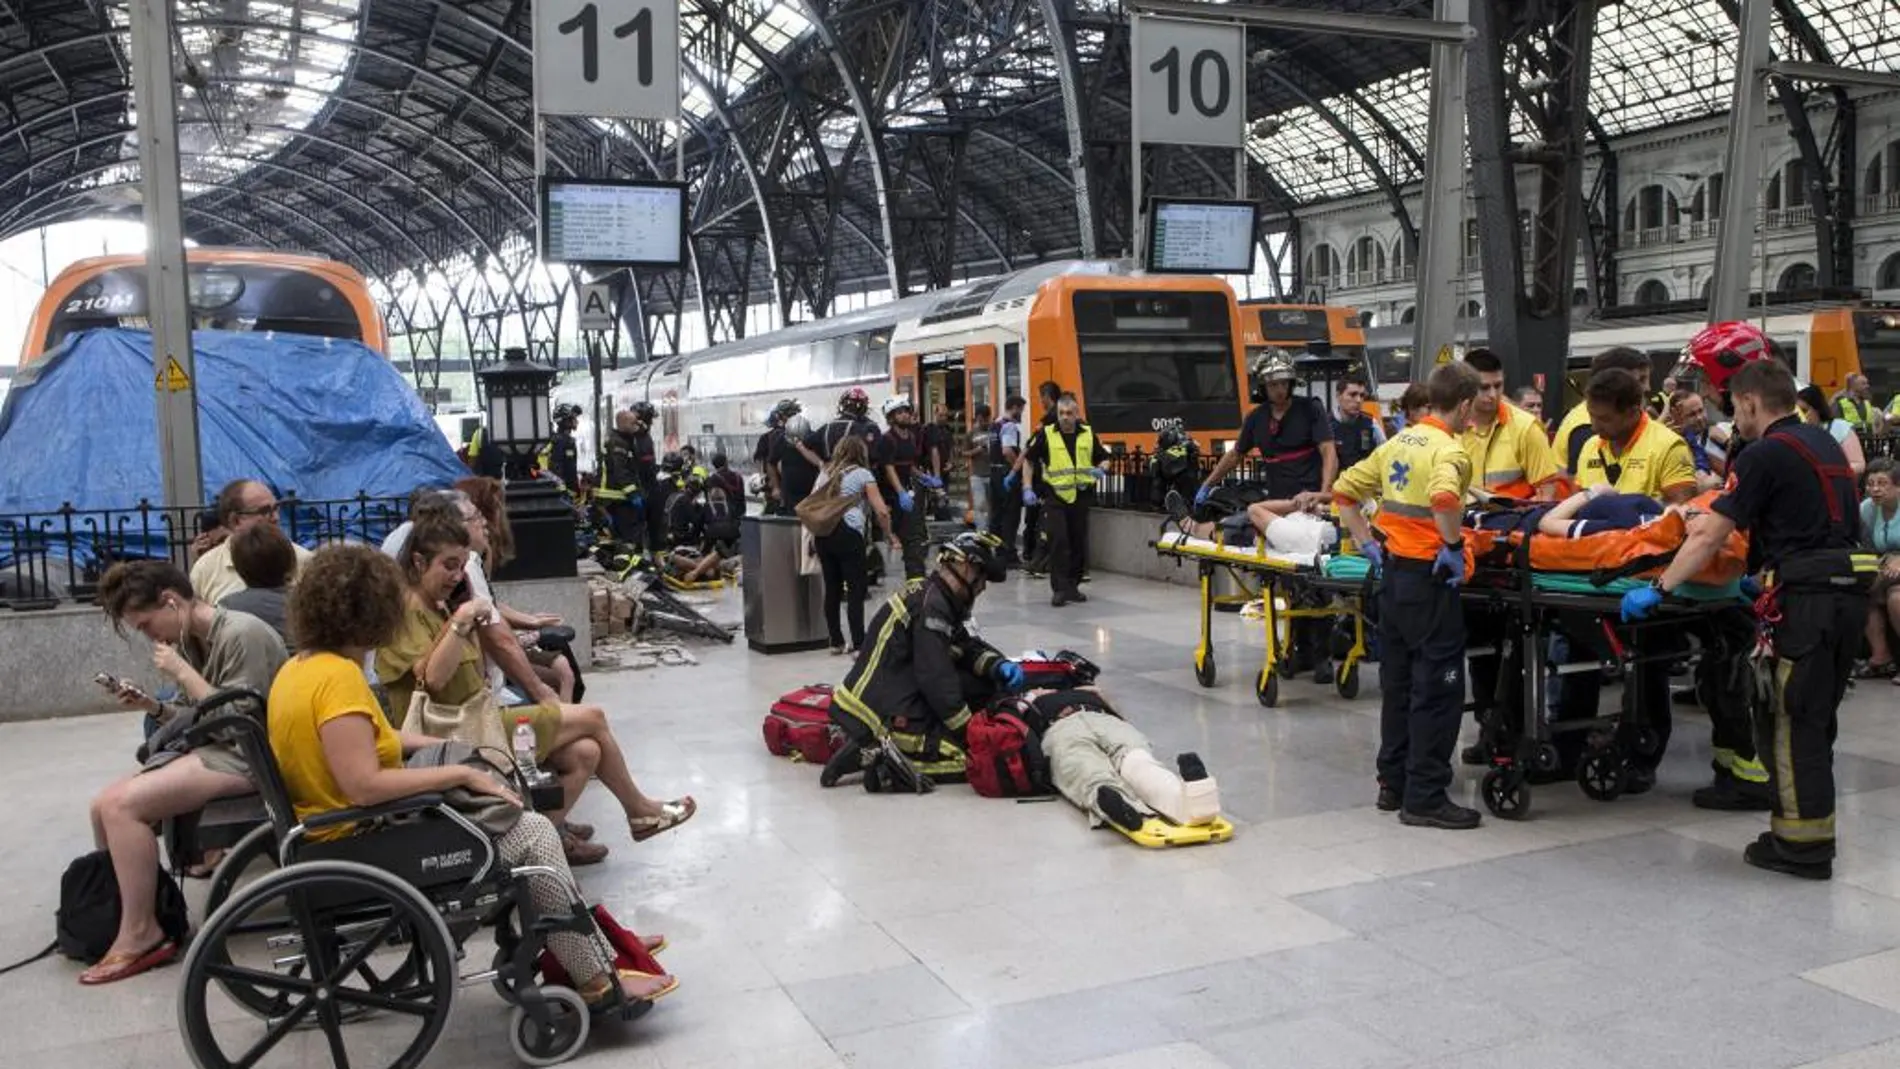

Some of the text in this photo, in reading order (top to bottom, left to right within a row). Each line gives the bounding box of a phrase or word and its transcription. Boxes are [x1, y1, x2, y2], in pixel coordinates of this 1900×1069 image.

[558, 3, 653, 86] 11
[1149, 46, 1230, 117] 10
[65, 294, 134, 313] 210M
[584, 290, 606, 314] A
[1308, 290, 1319, 304] A
